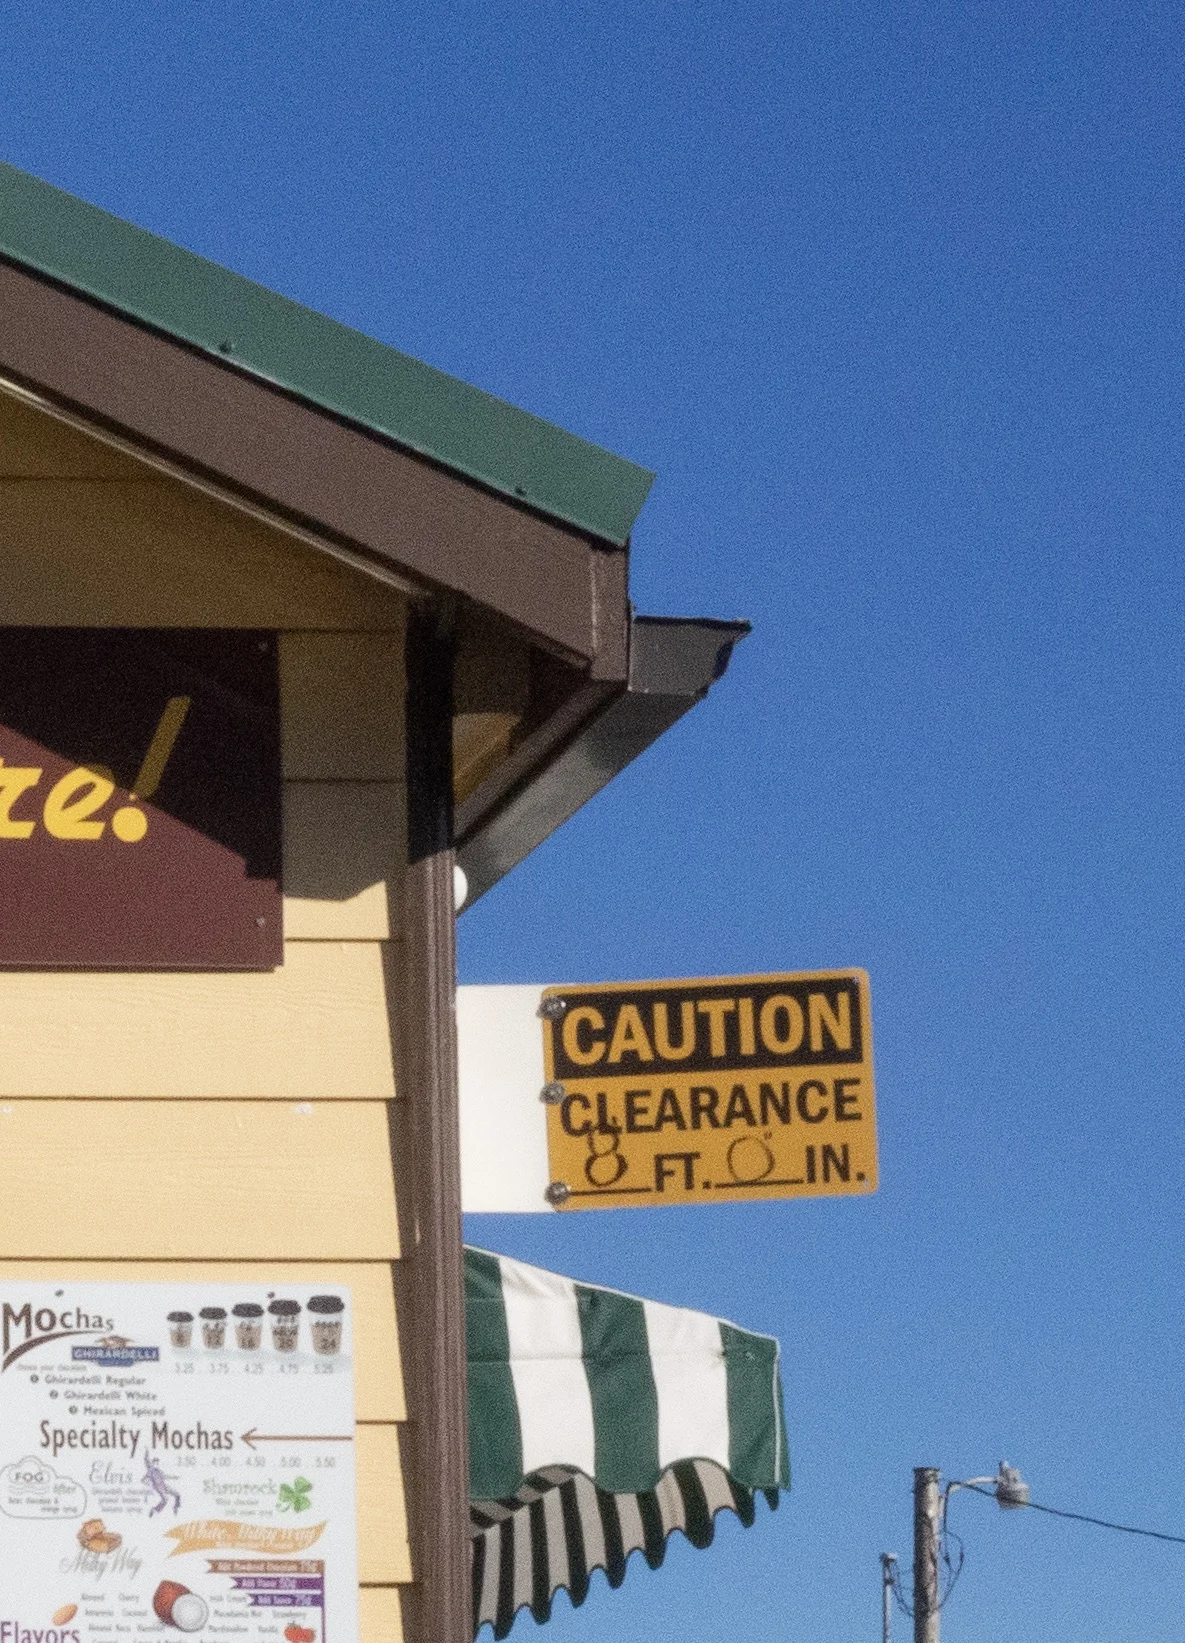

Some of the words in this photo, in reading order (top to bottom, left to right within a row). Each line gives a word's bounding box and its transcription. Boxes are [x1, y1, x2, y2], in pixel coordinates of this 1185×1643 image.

[561, 991, 853, 1068] CAUTION
[560, 1077, 863, 1137] CLEARANCE
[653, 1151, 712, 1192] FT.
[805, 1143, 866, 1184] IN.
[2, 1302, 115, 1357] Mochas
[72, 1349, 157, 1360] GHIRARDELLI
[40, 1420, 140, 1458] Specialty
[151, 1420, 234, 1451] Mochas
[14, 1471, 44, 1483] FOG
[88, 1459, 133, 1485] Elvis
